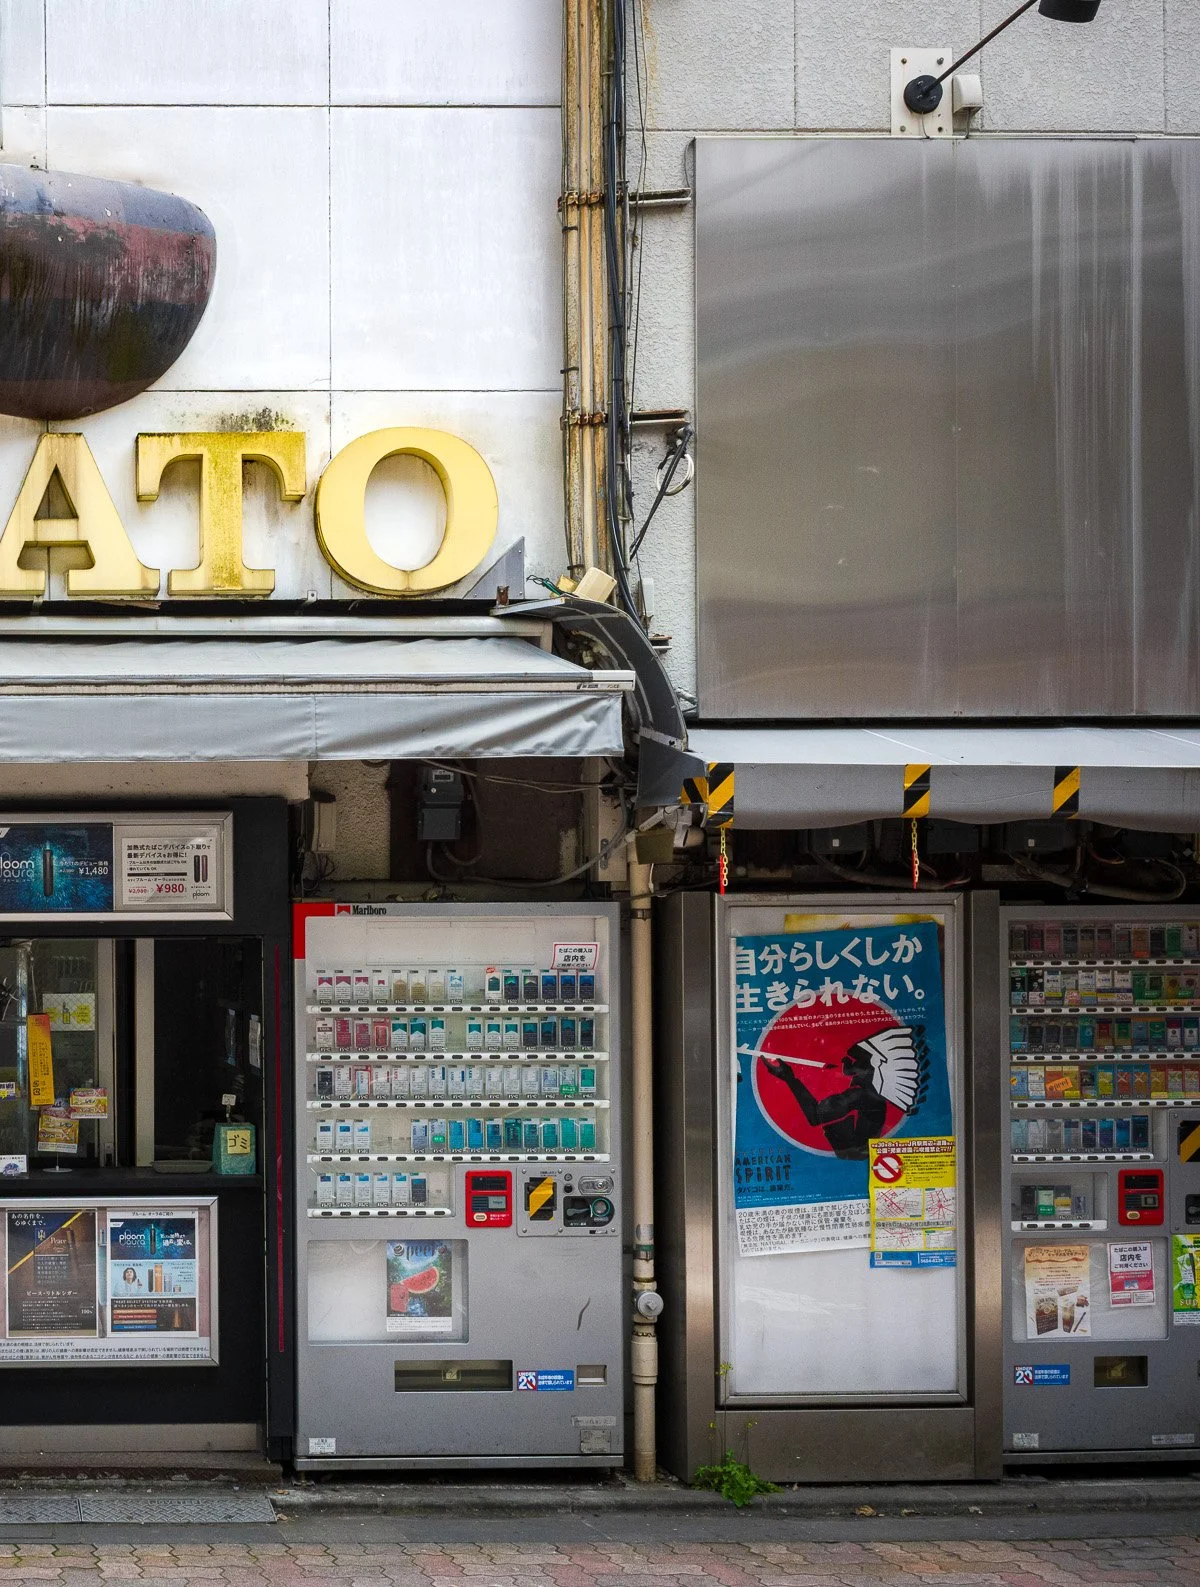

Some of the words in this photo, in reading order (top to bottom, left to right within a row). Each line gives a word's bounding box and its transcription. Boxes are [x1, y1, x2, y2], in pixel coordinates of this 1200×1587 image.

[78, 866, 109, 876] ¥1,480
[156, 883, 185, 894] ¥980
[193, 890, 209, 899] ploom
[353, 904, 387, 916] Marlboro
[735, 934, 922, 976] 自分らしくしか
[735, 973, 926, 1014] 生きられない。
[228, 1133, 248, 1150] ゴミ
[735, 1154, 792, 1166] AMERICAN
[735, 1165, 791, 1184] SPIRIT
[119, 1232, 146, 1244] ploom
[1120, 1254, 1142, 1262] 店内を
[518, 1375, 536, 1390] 20
[1015, 1370, 1033, 1384] 20
